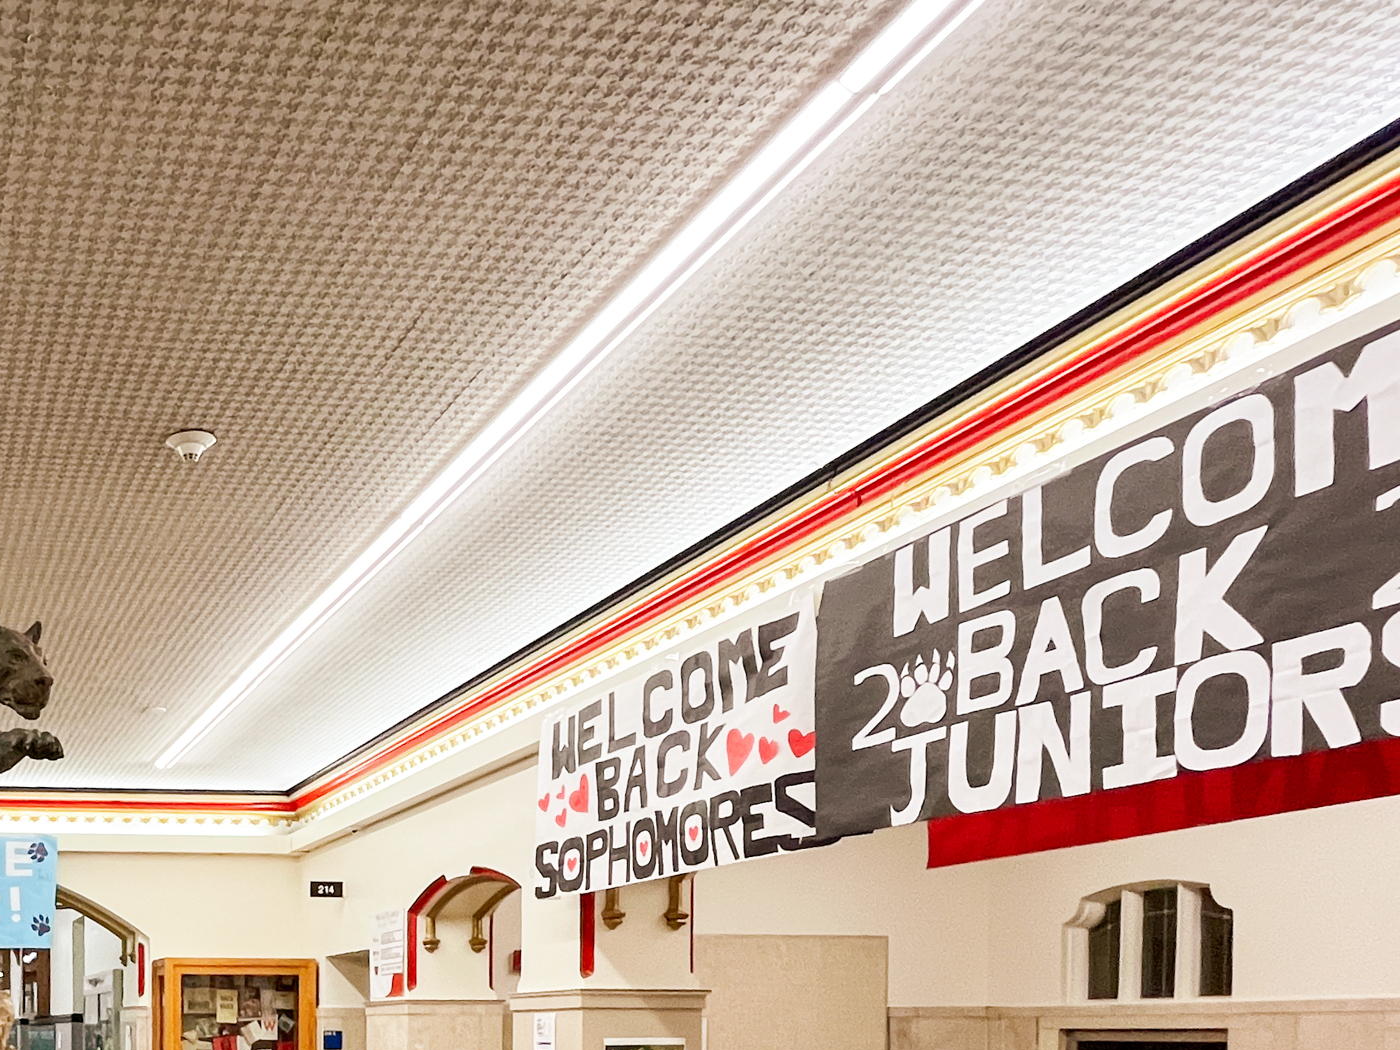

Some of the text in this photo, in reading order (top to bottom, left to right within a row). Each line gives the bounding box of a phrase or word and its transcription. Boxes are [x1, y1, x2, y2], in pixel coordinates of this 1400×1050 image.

[955, 525, 1268, 716] BACK
[552, 611, 800, 780] WELCOME
[535, 770, 835, 899] SOPHOMORES
[595, 722, 726, 822] BACK
[318, 885, 334, 895] 214
